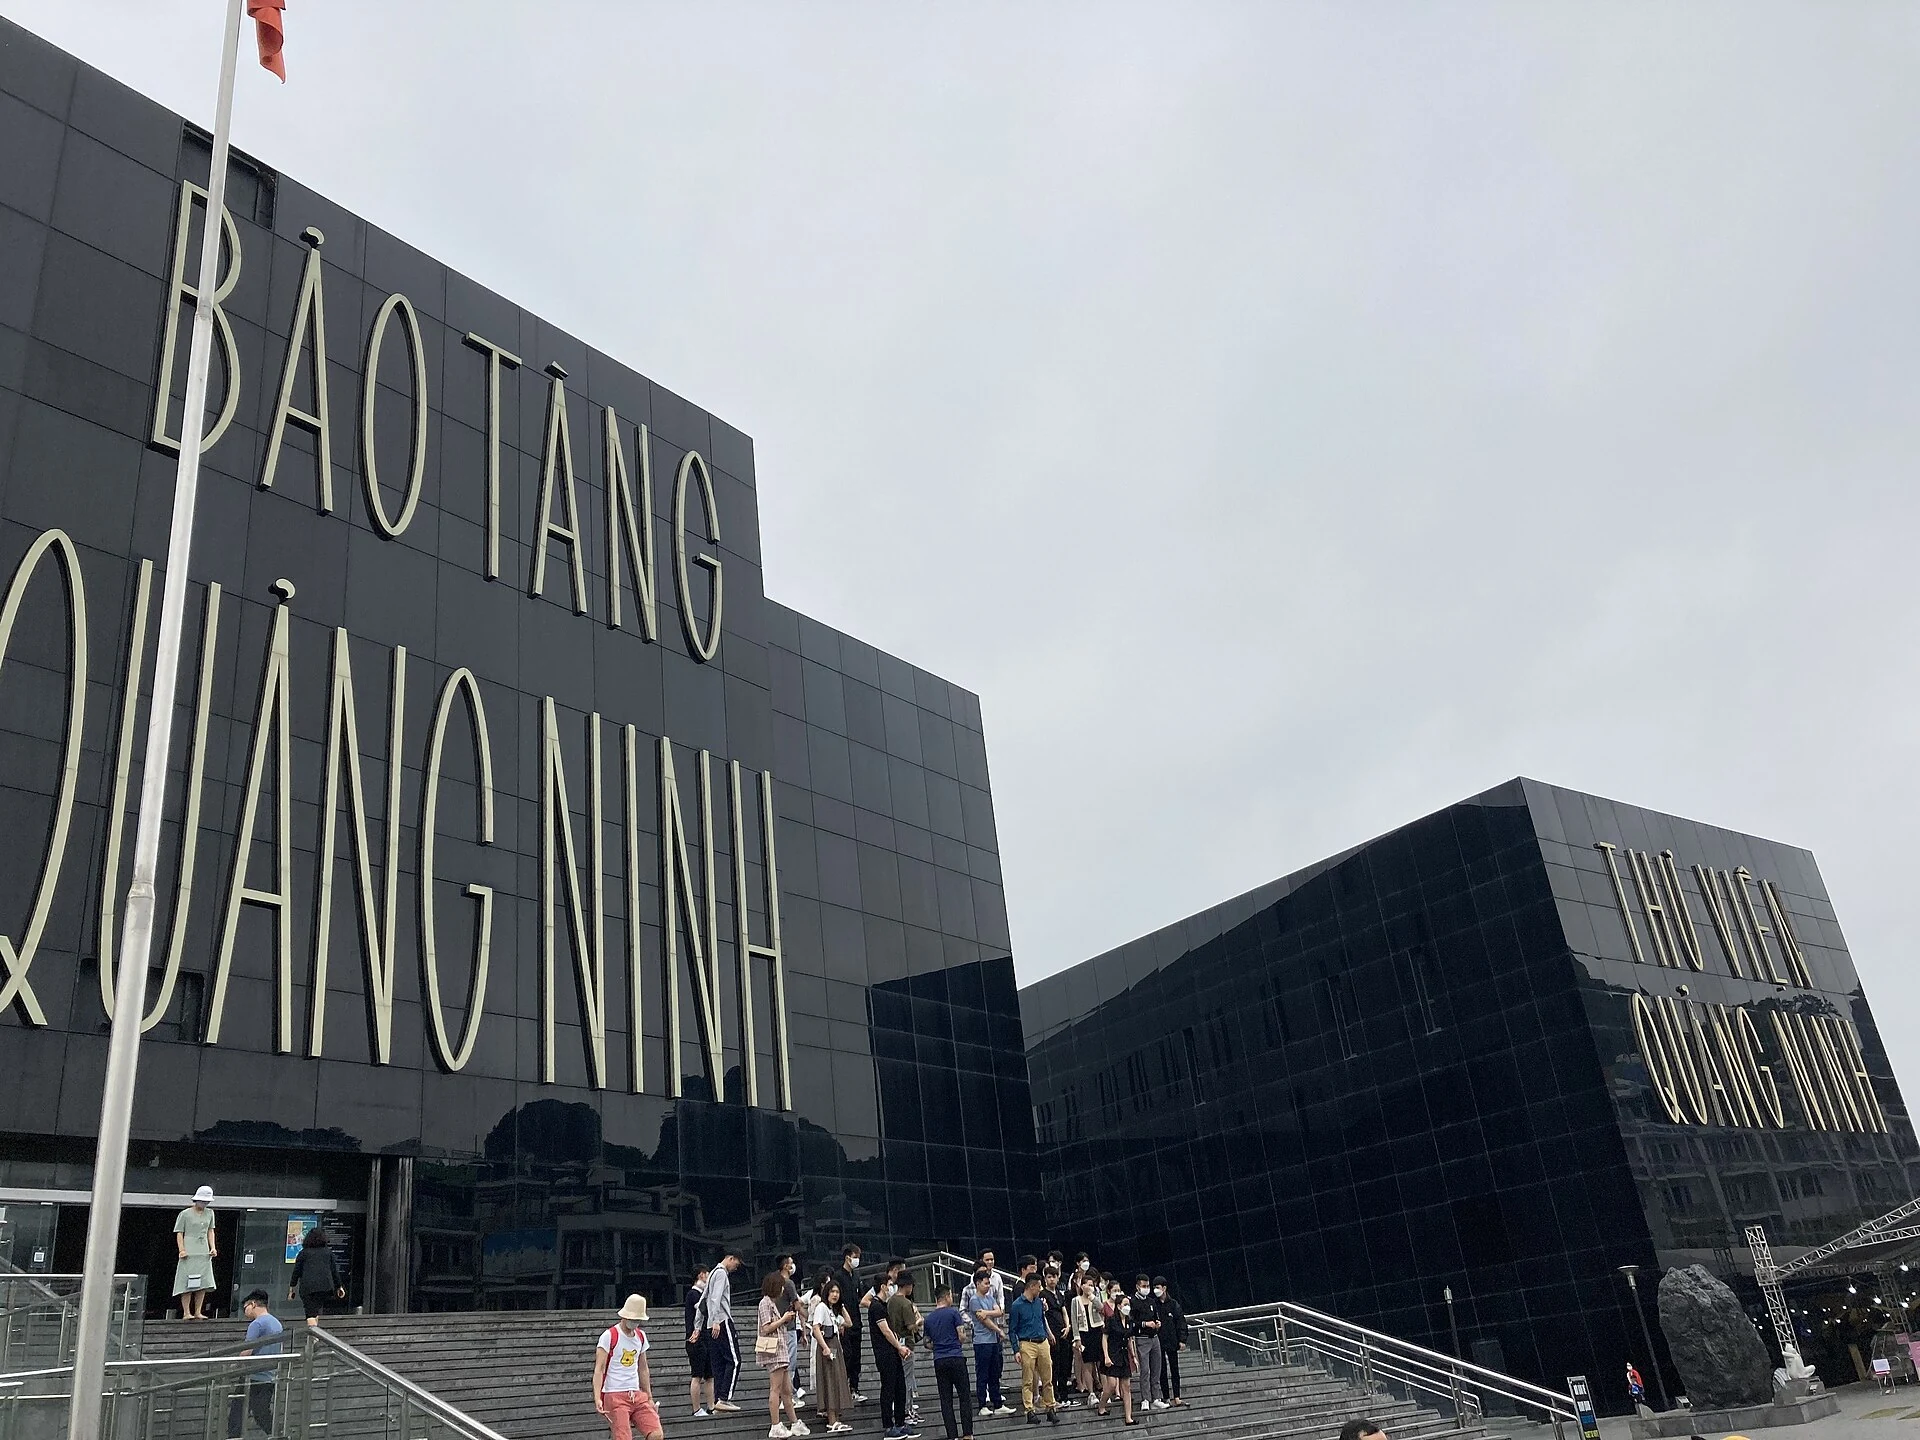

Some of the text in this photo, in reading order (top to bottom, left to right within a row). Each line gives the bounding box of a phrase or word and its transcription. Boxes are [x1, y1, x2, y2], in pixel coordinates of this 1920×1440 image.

[150, 178, 722, 663] BẢO TÀNG
[0, 528, 792, 1111] QUẢNG NINH
[1631, 984, 1888, 1134] QUẢNG NINH
